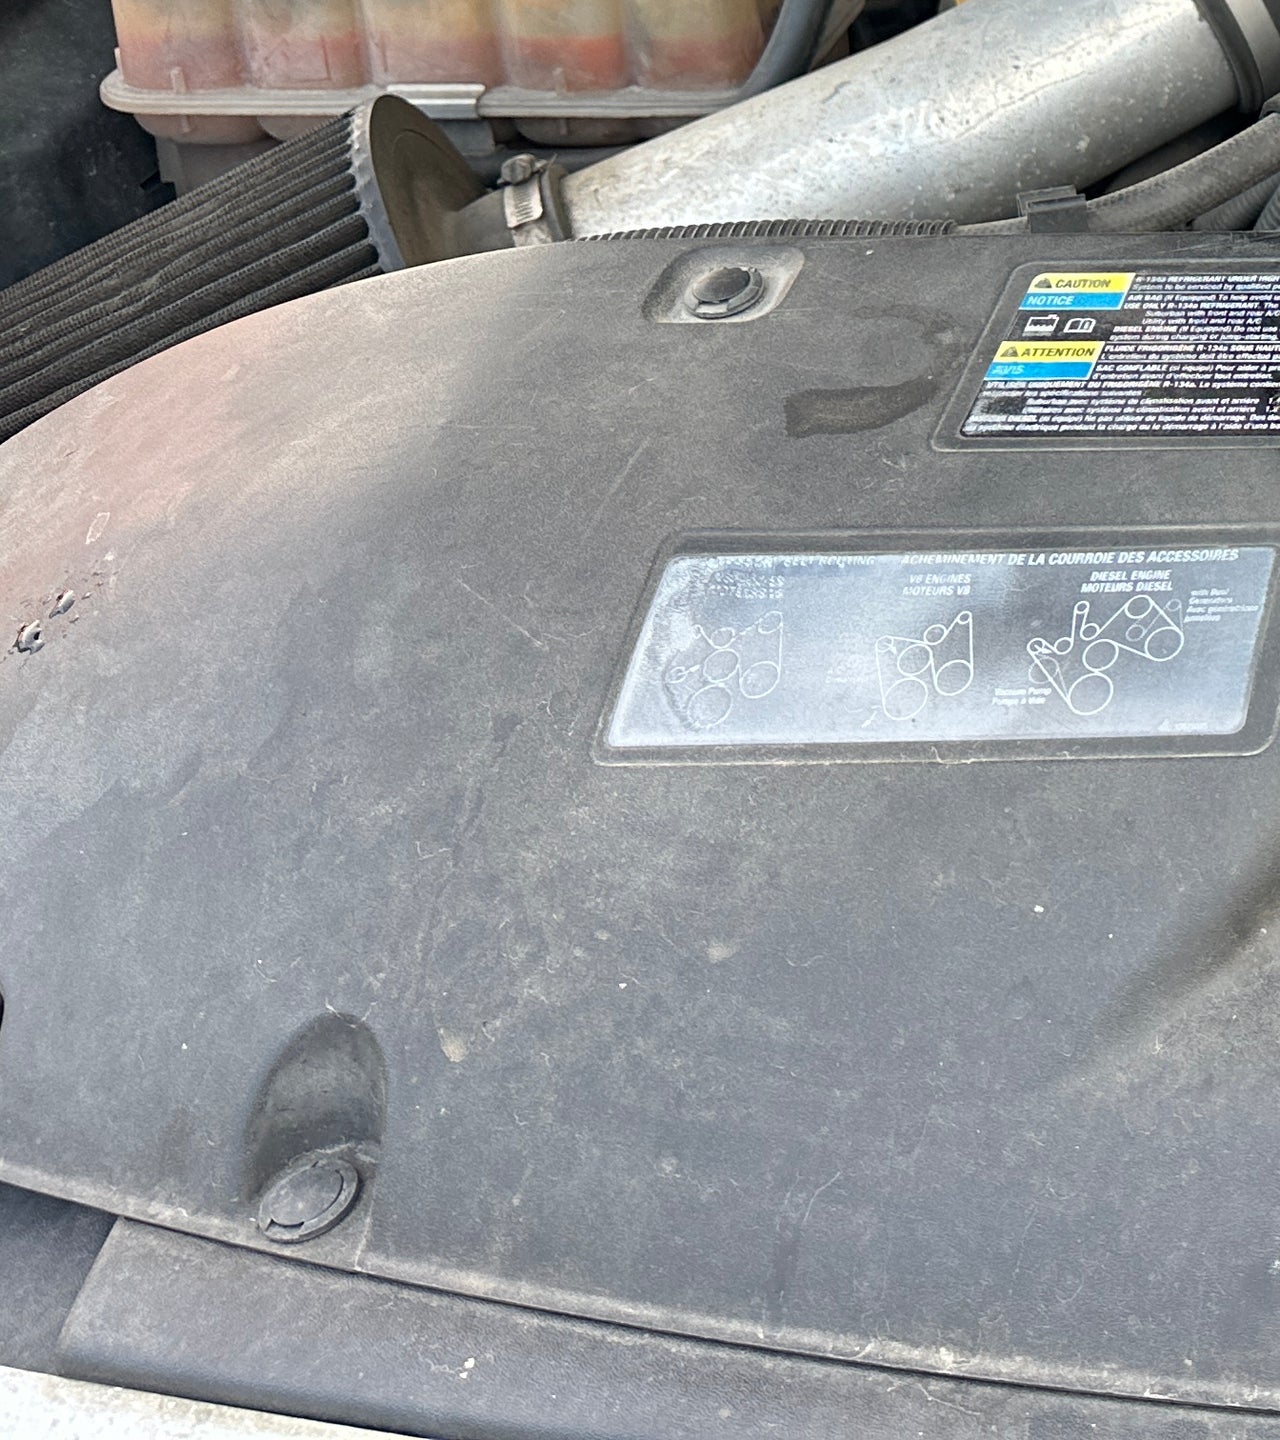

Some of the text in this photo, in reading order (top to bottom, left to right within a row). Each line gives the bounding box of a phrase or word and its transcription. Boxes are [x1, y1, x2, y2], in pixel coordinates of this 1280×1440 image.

[1055, 279, 1112, 288] CAUTION
[1026, 295, 1075, 305] NOTICE
[1021, 348, 1096, 357] ATTENTION
[900, 554, 1005, 565] ACHEMINEMENT
[1007, 554, 1027, 565] DE
[1028, 554, 1046, 565] LA
[1048, 552, 1116, 565] COURROIE
[1118, 551, 1145, 564] DES
[1148, 549, 1240, 562] ACCESSOIRES
[926, 573, 972, 583] ENGINES
[1090, 569, 1173, 581] DIESEL ENGINE
[902, 586, 954, 596] MOTEURS
[1080, 581, 1174, 593] MOTEURS DIESEL
